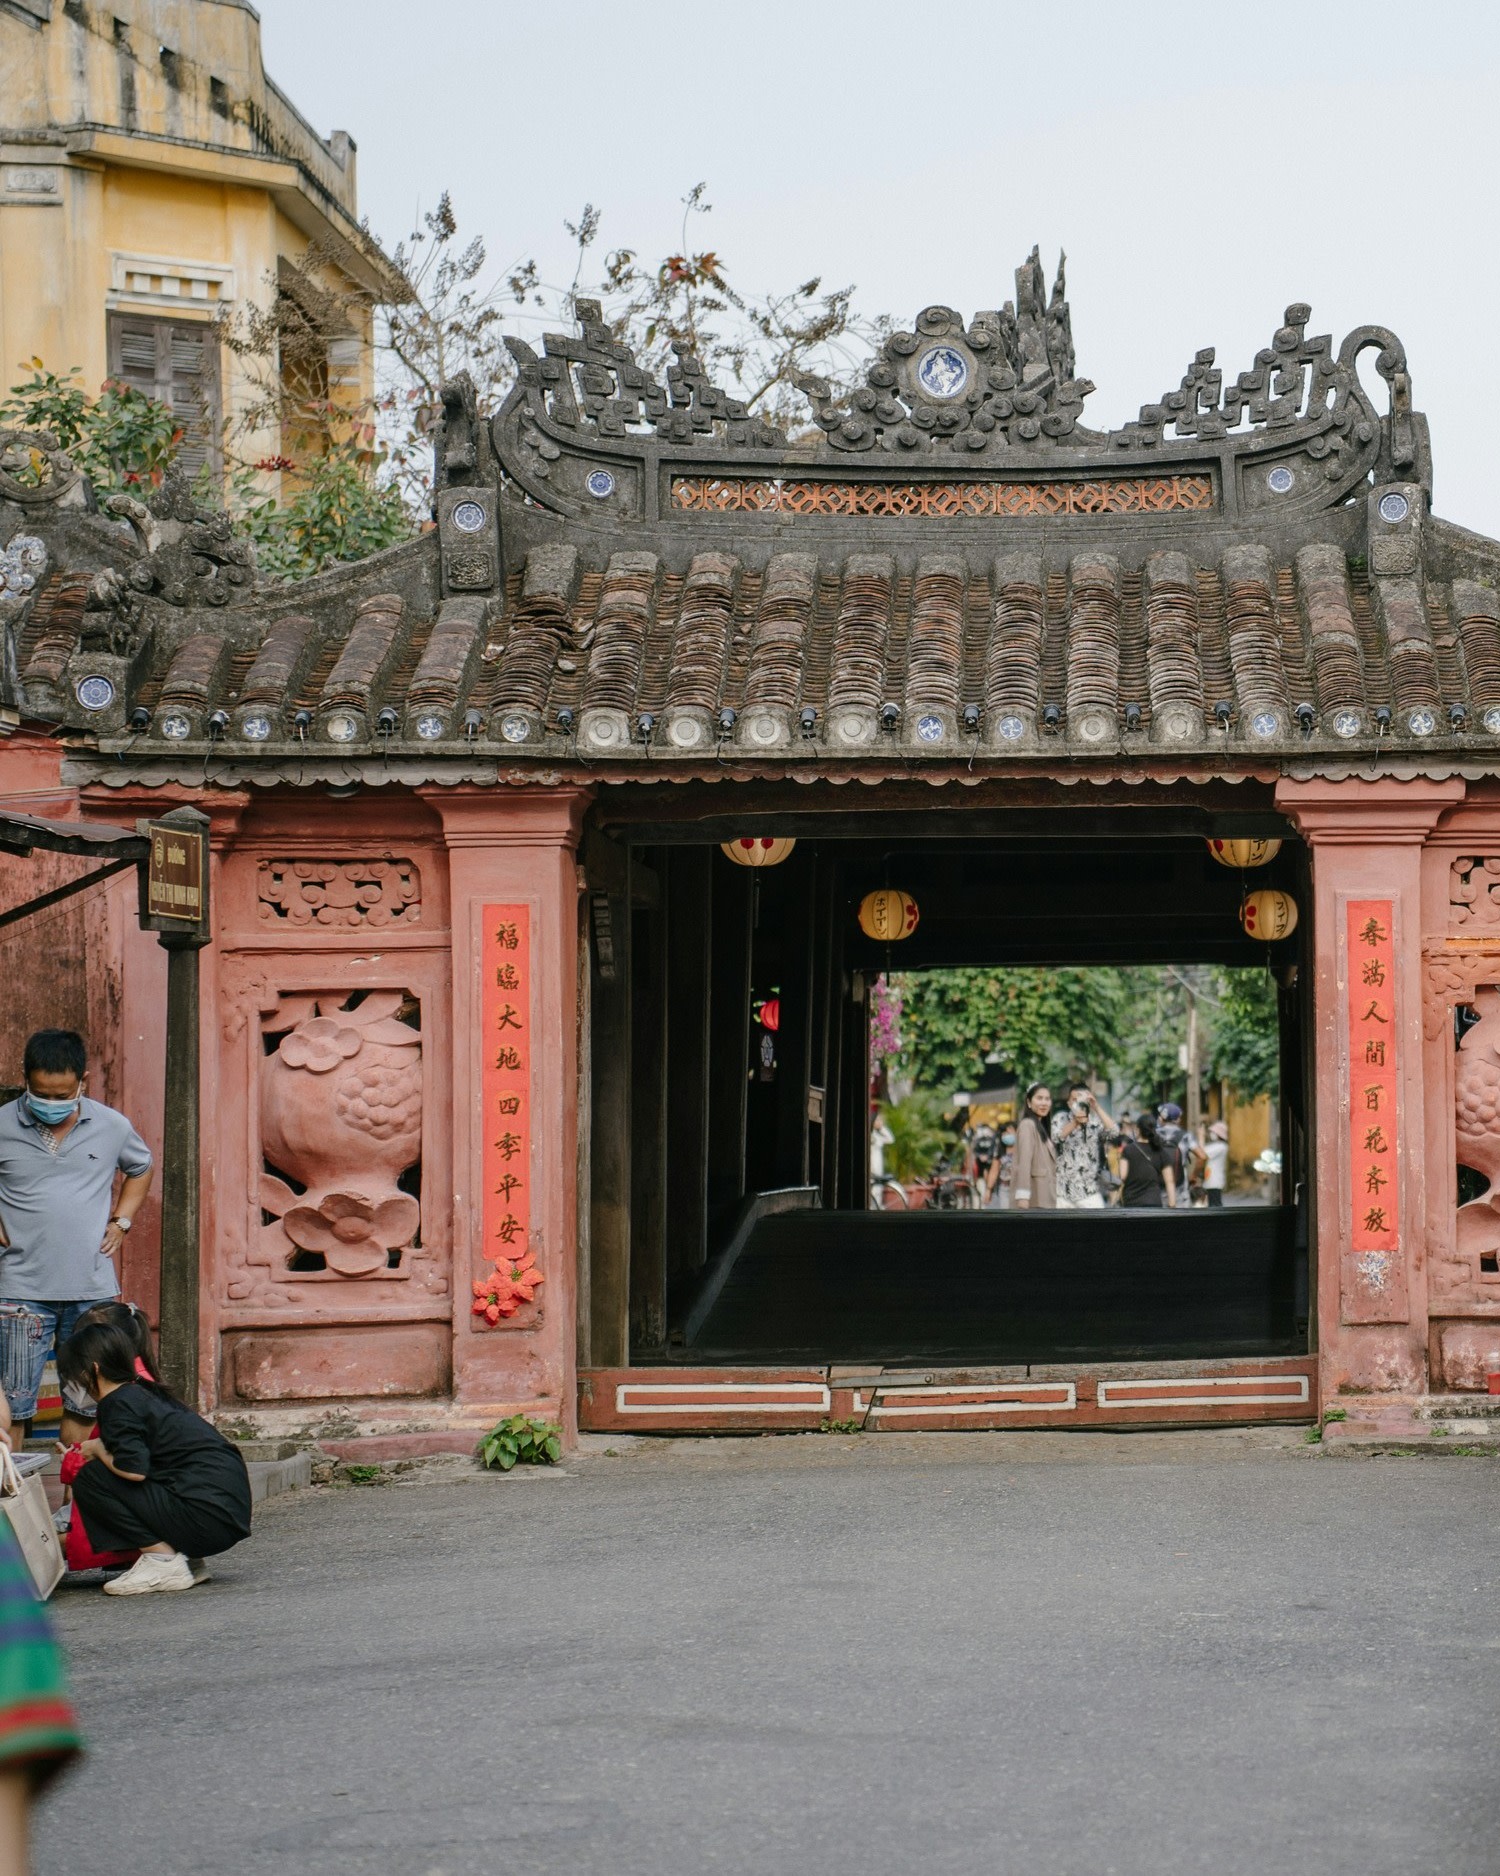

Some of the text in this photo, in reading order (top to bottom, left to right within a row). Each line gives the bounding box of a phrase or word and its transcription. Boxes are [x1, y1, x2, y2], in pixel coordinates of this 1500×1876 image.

[495, 922, 524, 1245] 福臨大地四季平安
